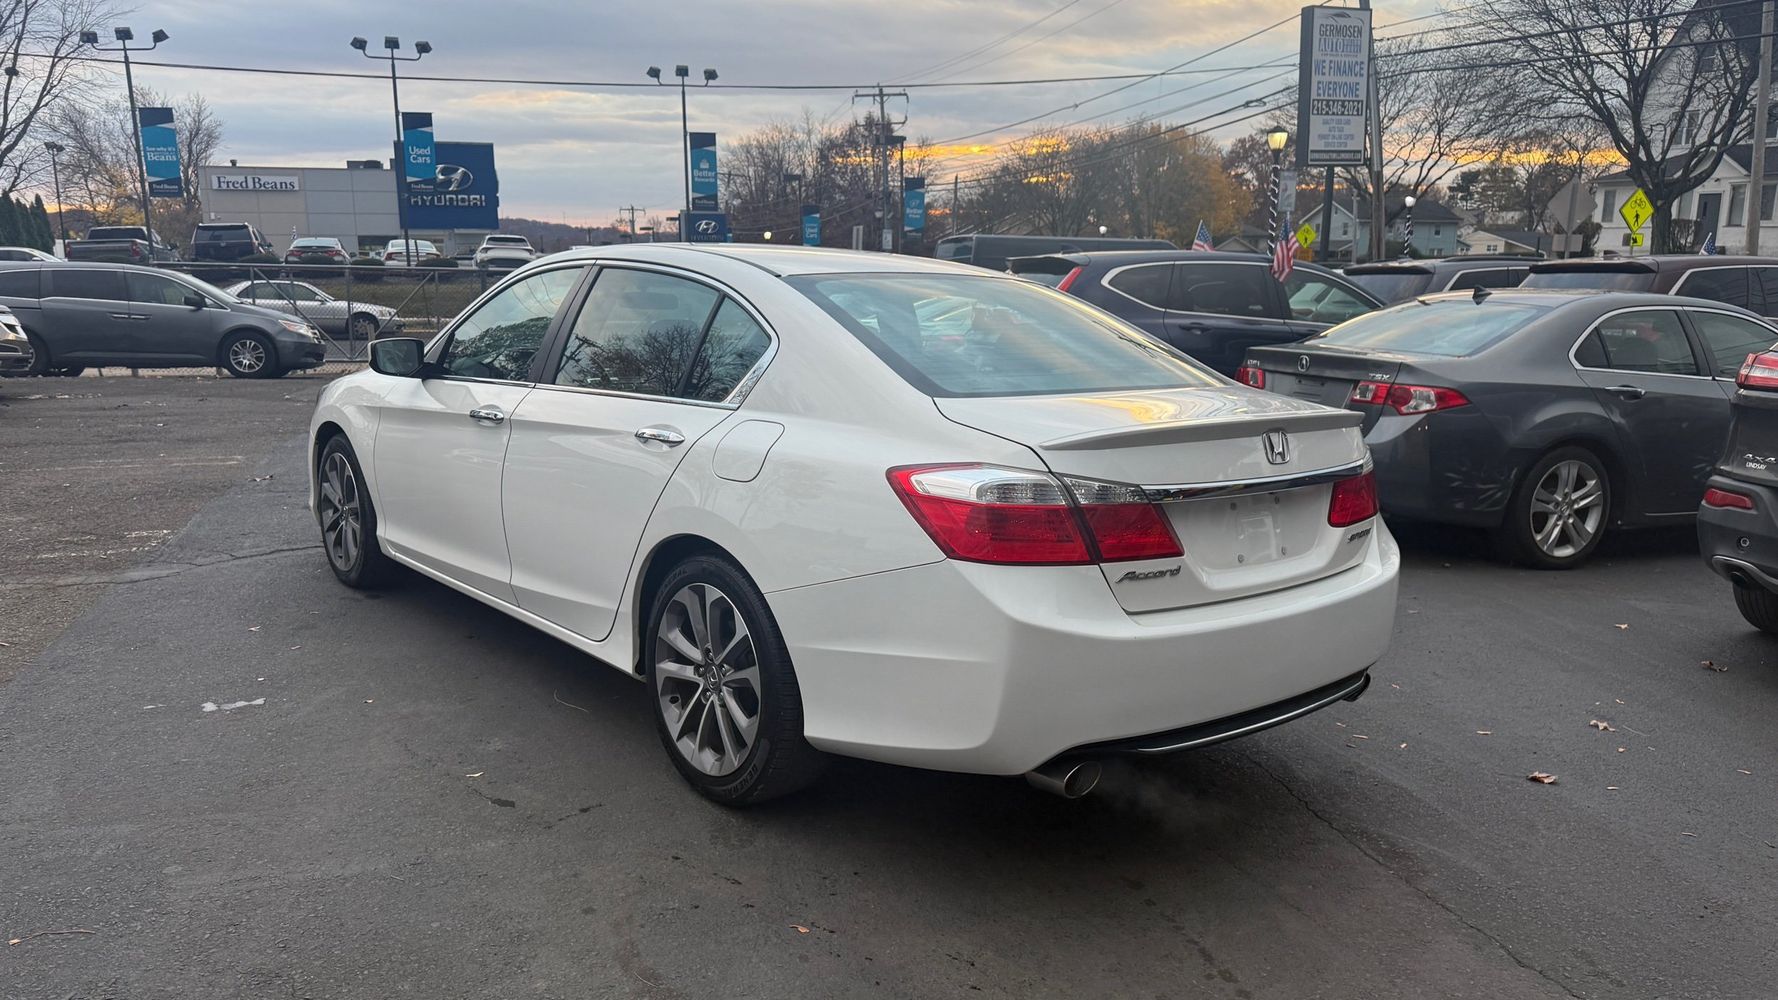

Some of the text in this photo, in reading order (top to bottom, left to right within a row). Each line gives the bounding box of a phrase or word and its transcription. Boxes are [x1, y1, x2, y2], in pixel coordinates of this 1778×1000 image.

[1319, 24, 1363, 39] GERMOSEN
[1318, 38, 1344, 52] AUTO
[1314, 60, 1364, 77] WE FINANCE
[1317, 81, 1360, 98] EVERYONE
[1313, 100, 1362, 115] 215-346-2021
[146, 152, 177, 161] Beans
[408, 146, 431, 155] Used
[410, 154, 431, 164] Cars
[693, 169, 716, 177] Better
[216, 176, 296, 190] Fred Beans
[411, 194, 486, 207] HYUNDAI
[1115, 565, 1182, 583] Accord
